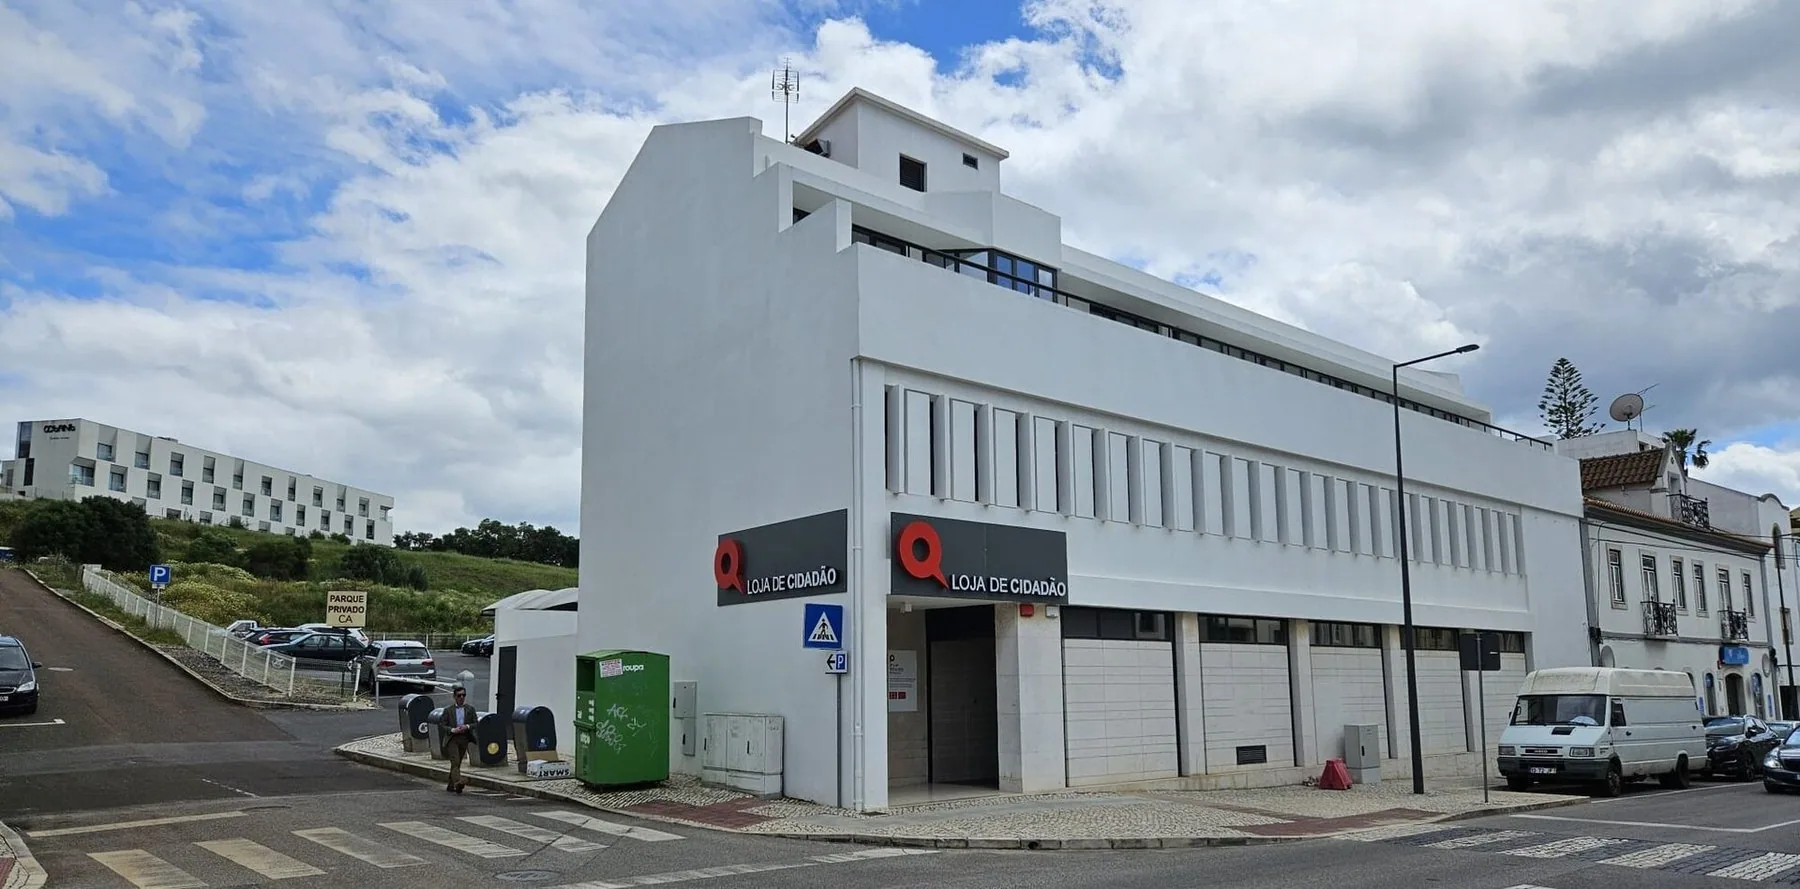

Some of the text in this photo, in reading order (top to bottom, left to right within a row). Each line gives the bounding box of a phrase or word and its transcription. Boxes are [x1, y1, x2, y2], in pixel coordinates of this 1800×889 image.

[153, 567, 167, 581] P
[747, 565, 837, 594] LOJA DE CIDADÃO
[951, 574, 1067, 597] LOJA DE CIDADÃO
[330, 595, 365, 603] PARQUE
[328, 605, 365, 613] PRIVADO
[338, 615, 353, 623] CA
[837, 655, 844, 669] P
[540, 768, 570, 778] SMART
